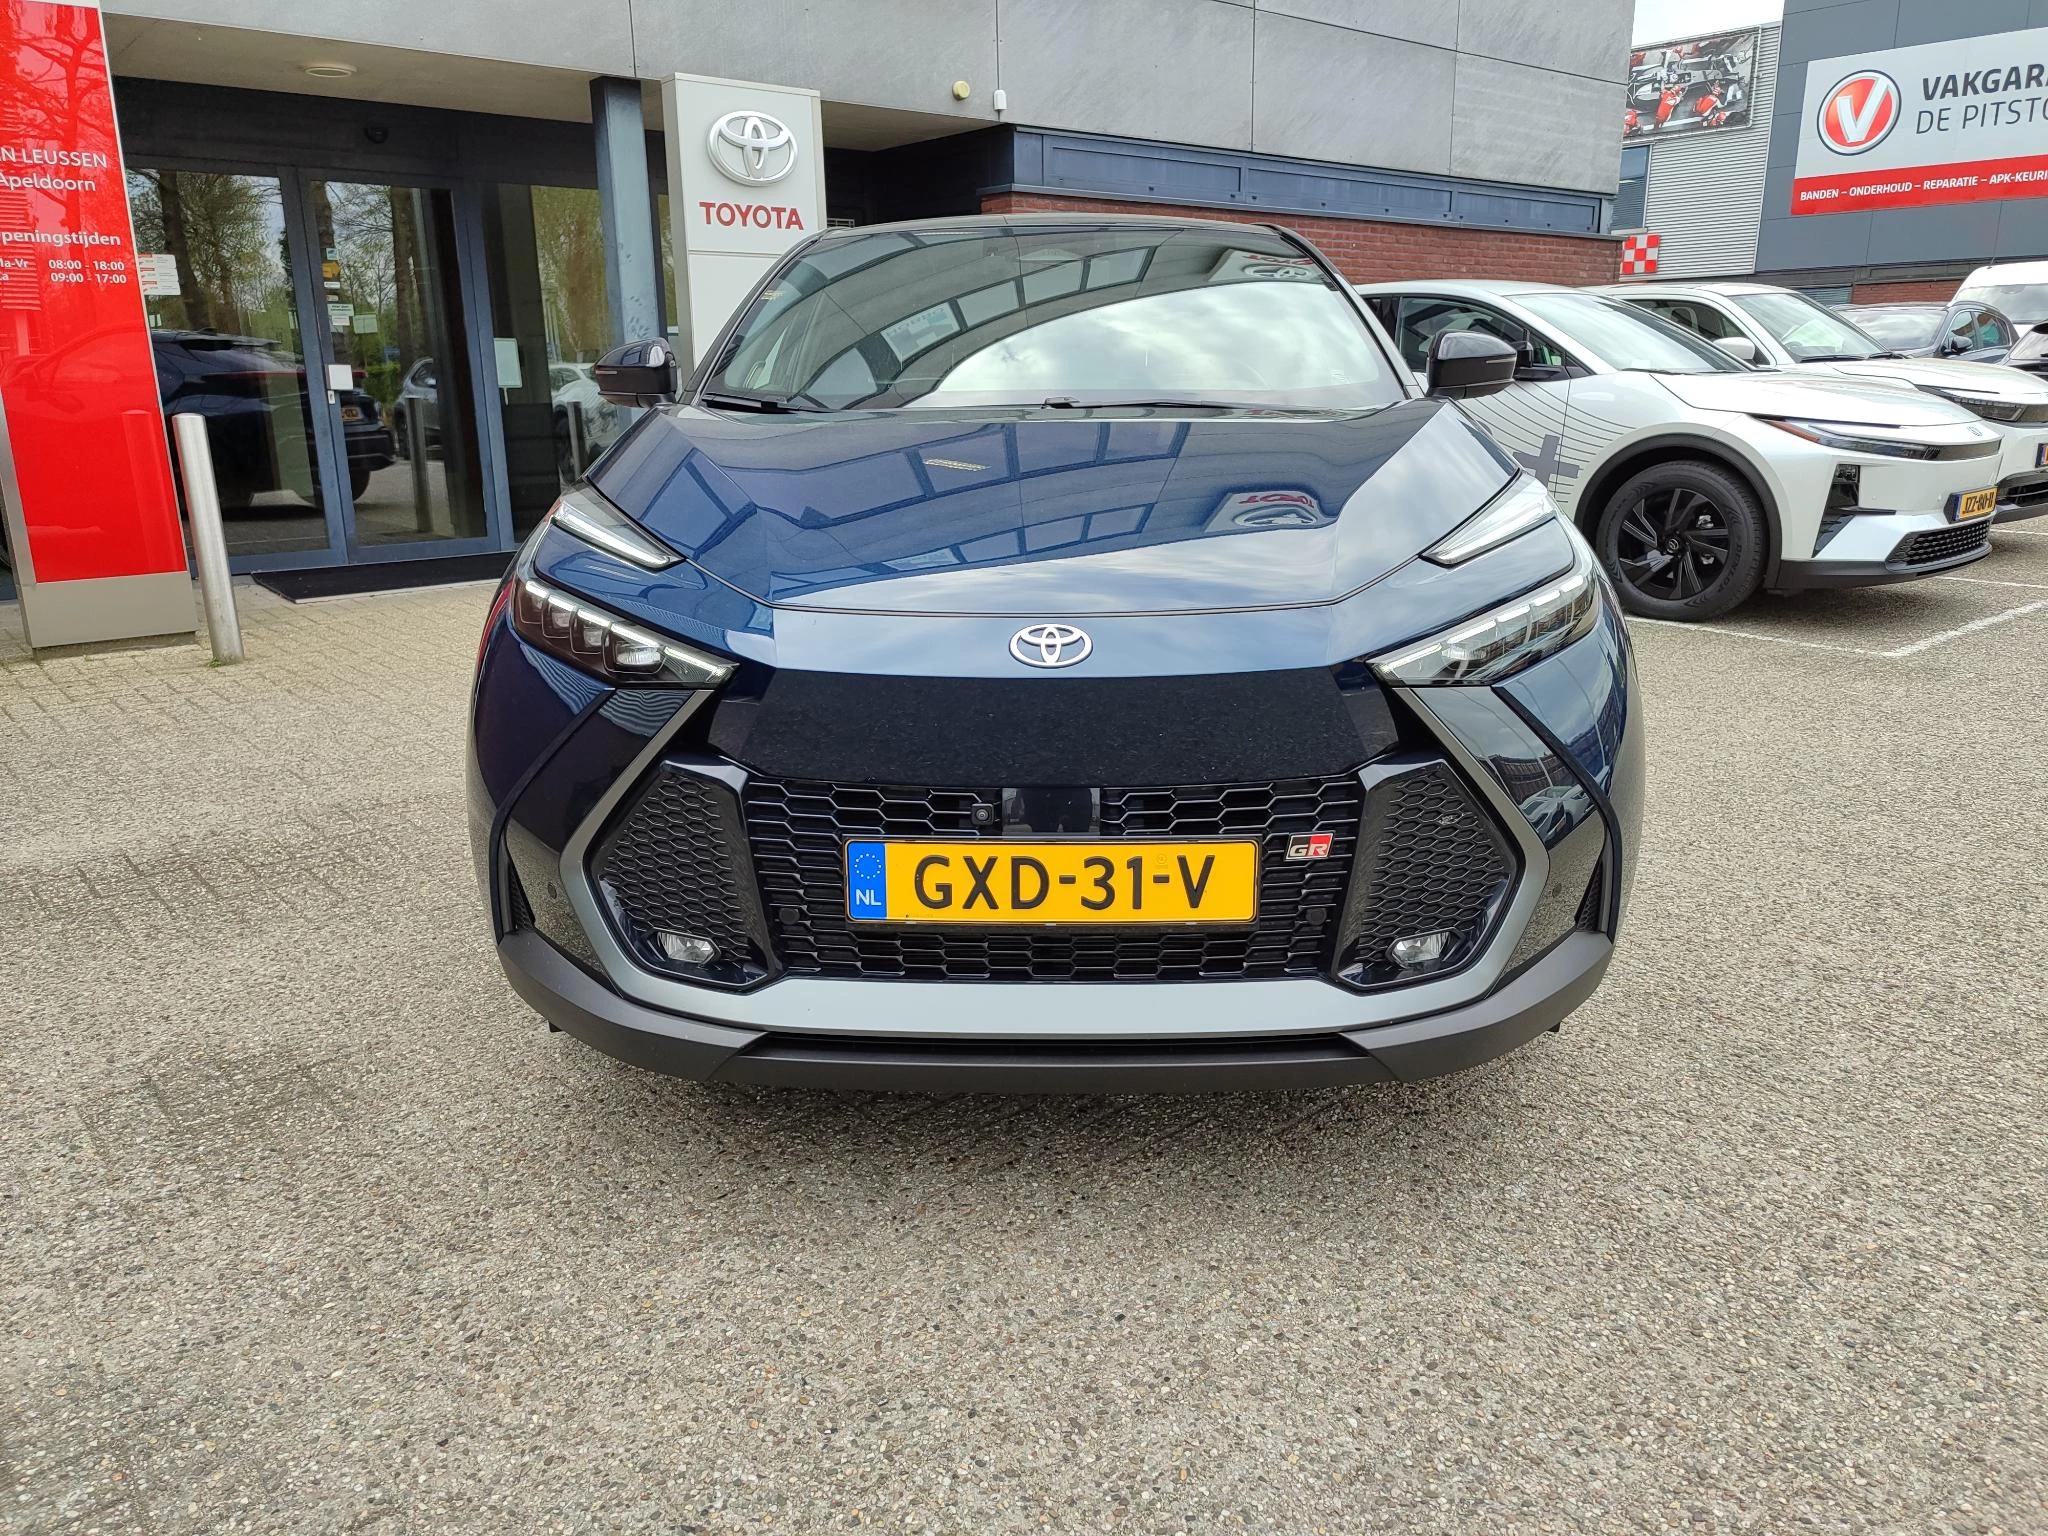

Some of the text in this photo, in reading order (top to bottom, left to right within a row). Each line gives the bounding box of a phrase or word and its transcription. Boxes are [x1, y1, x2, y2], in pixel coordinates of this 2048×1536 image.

[1922, 64, 2048, 101] VAKGAR
[1916, 107, 1951, 134] DE
[0, 147, 107, 168] N LEUSSEN
[0, 172, 96, 191] Apeldoorn
[1800, 188, 1839, 201] BANDEN
[1849, 182, 1912, 196] ONDERHOUD
[1923, 176, 1979, 190] REPARATIE
[699, 201, 804, 231] TOYOTA
[48, 259, 82, 270] 08:00
[93, 260, 125, 271] 18:00
[50, 272, 84, 283] 09:00
[95, 273, 127, 284] 17:00
[1289, 844, 1328, 857] GR
[914, 854, 1216, 910] GXD-31-V
[855, 888, 882, 906] NL
